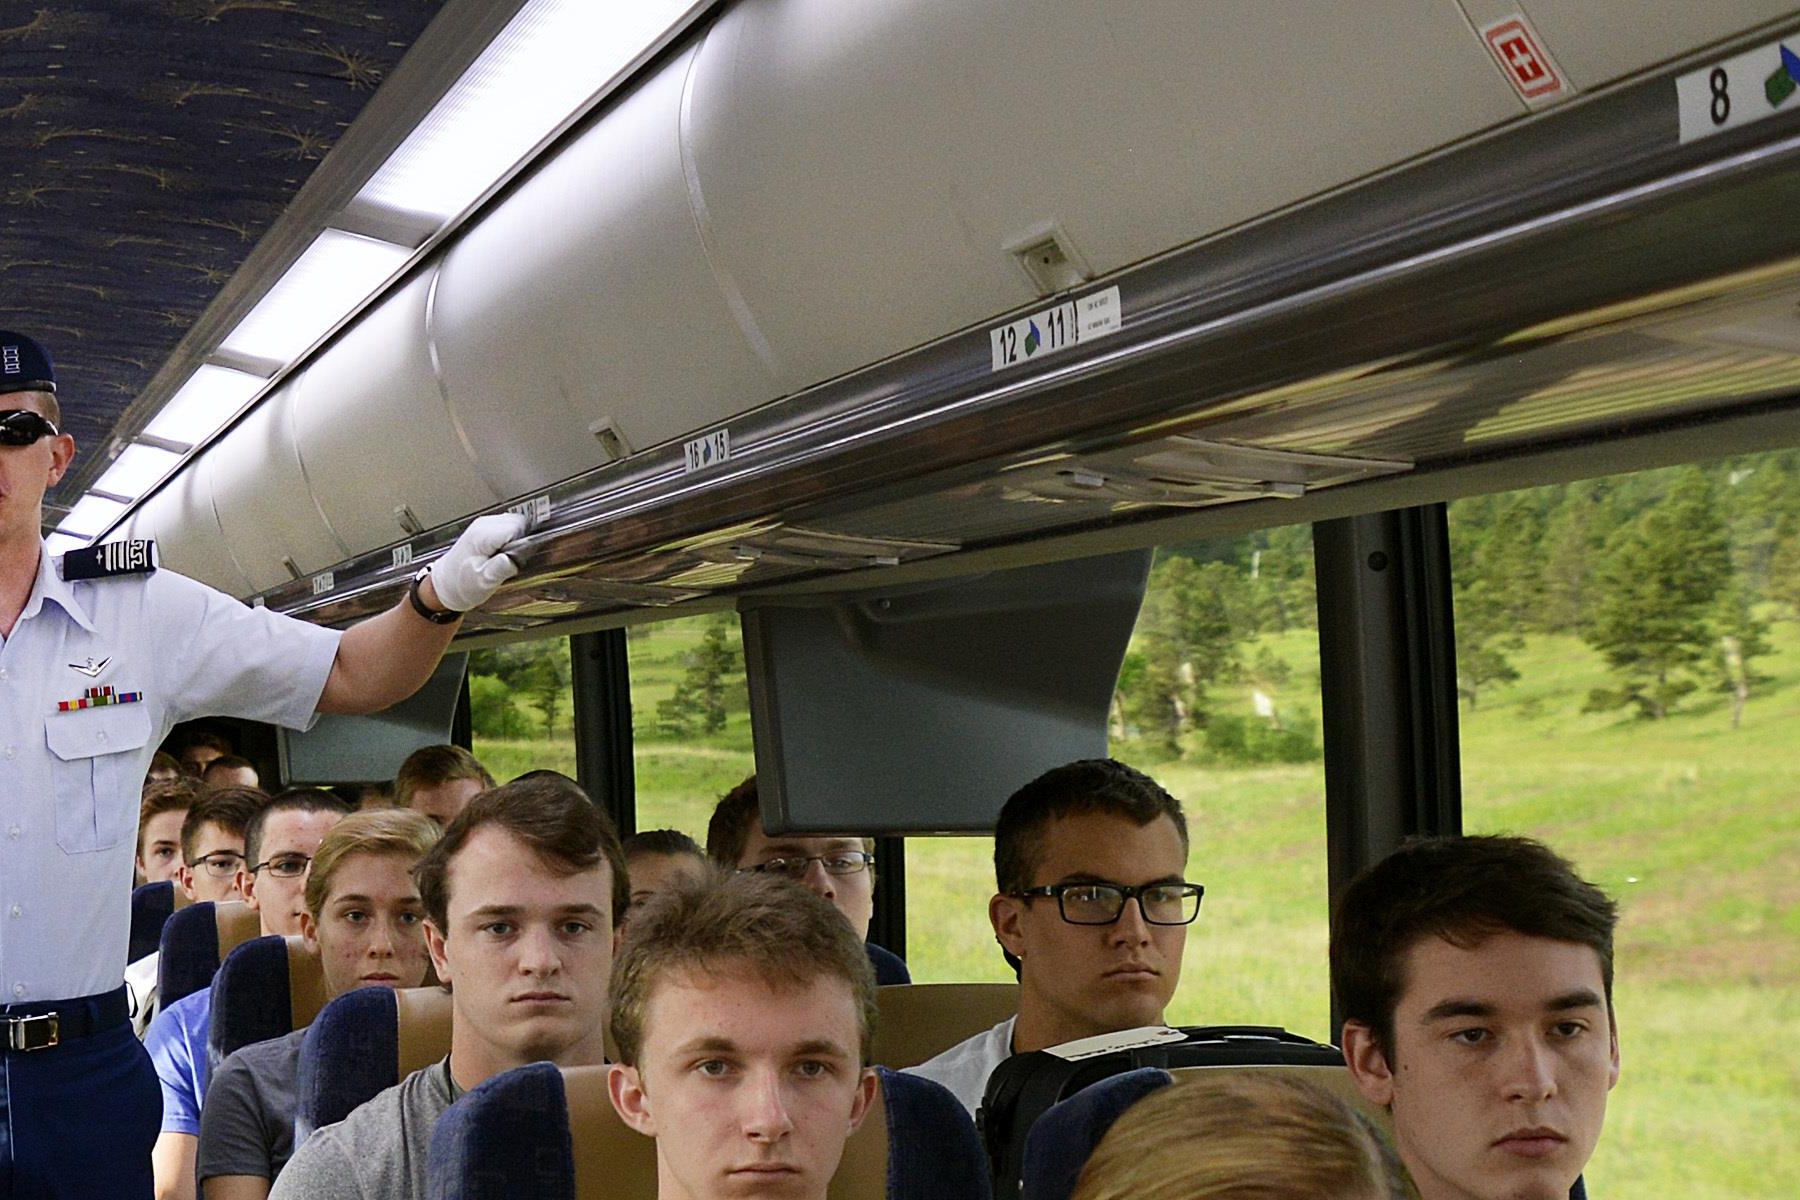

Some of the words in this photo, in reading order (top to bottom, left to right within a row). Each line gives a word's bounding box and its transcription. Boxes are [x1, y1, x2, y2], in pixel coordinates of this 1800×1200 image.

[1709, 67, 1731, 126] 8
[1000, 326, 1018, 366] 12
[1048, 307, 1065, 349] 11
[689, 442, 700, 470] 16
[714, 432, 726, 460] 15
